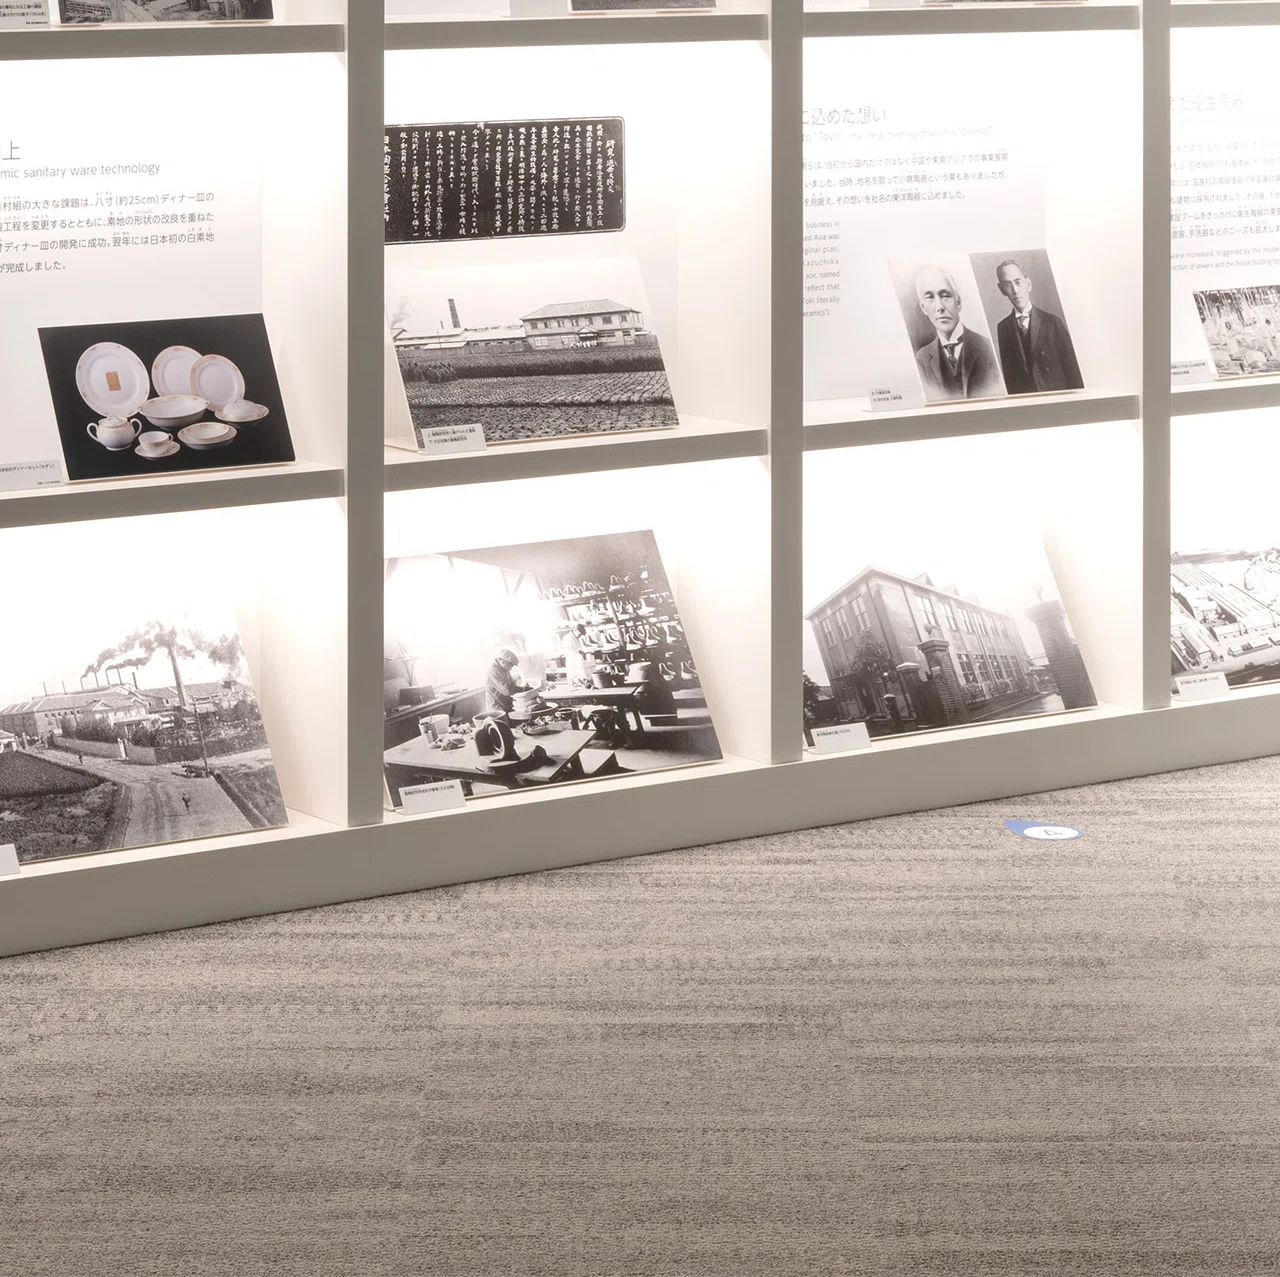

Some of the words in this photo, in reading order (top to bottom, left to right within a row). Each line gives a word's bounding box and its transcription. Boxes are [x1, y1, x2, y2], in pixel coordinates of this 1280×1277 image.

[23, 166, 67, 180] sanitary
[69, 166, 98, 176] ware
[100, 161, 161, 177] technology
